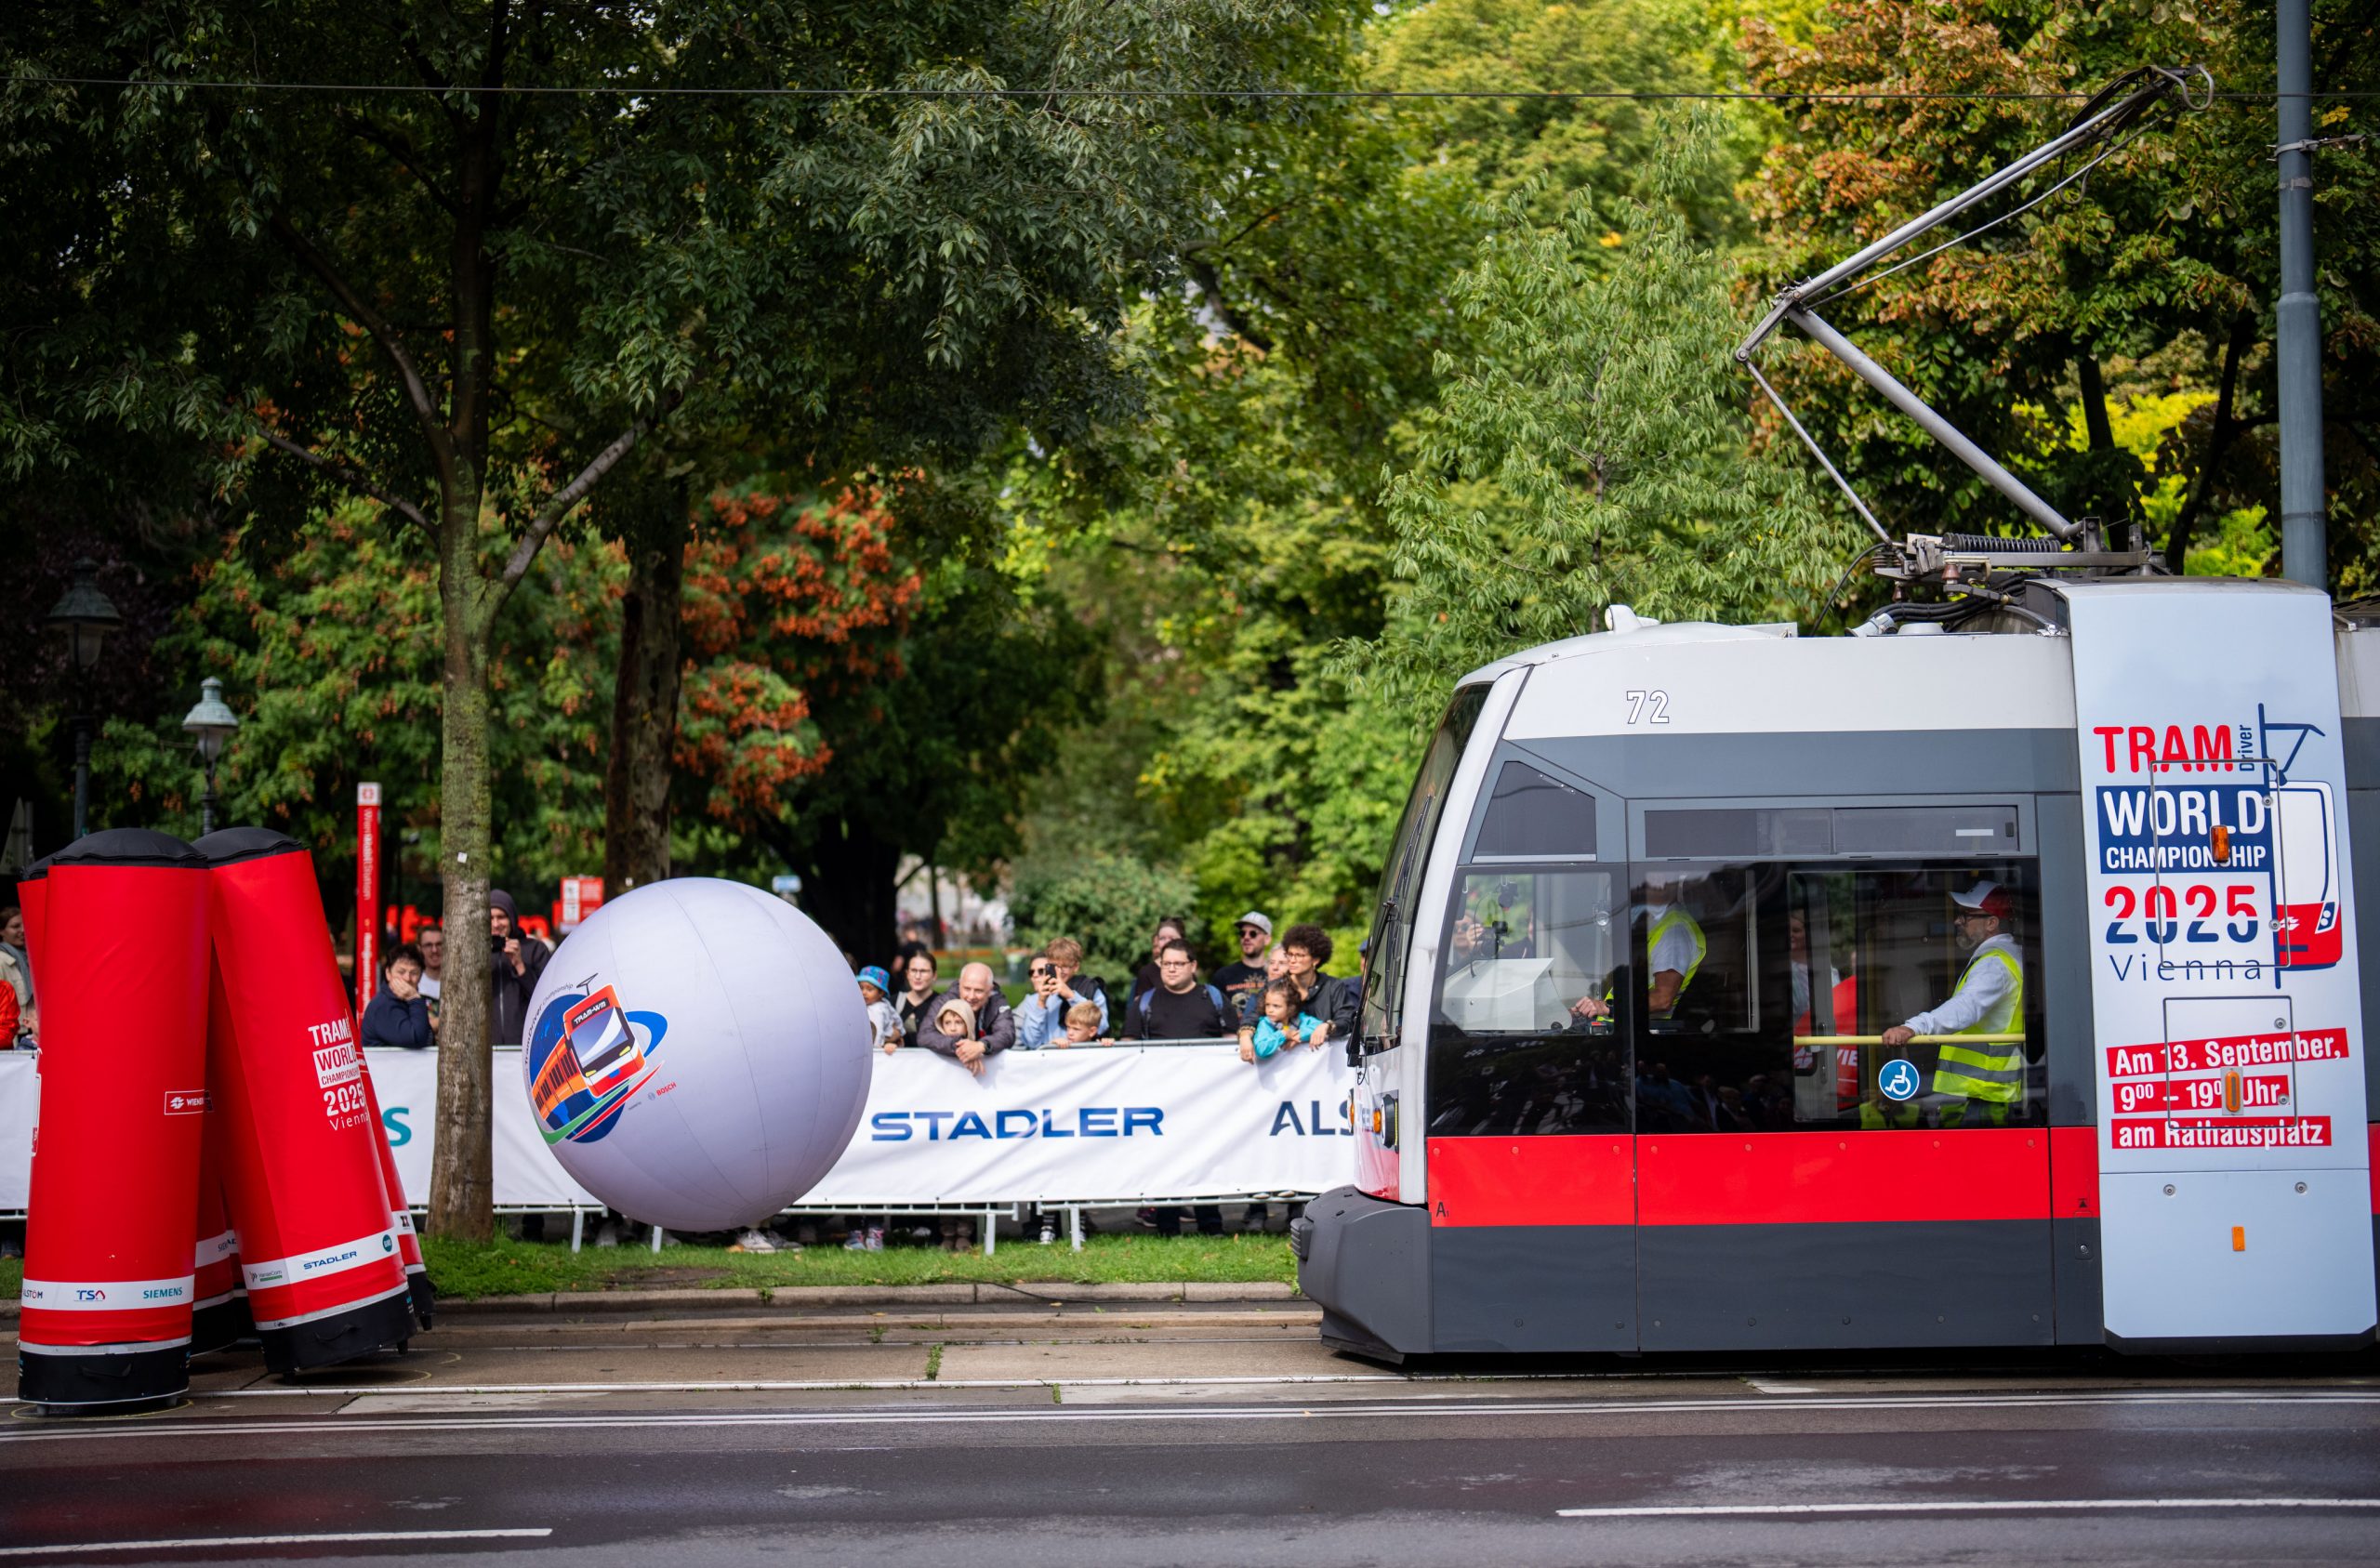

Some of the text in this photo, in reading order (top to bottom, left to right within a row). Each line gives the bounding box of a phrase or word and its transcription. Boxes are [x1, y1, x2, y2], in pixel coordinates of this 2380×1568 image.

[1626, 691, 1670, 724] 72
[2093, 724, 2234, 773] TRAM
[2238, 724, 2254, 771] Driver
[2103, 790, 2266, 836] WORLD
[2106, 846, 2267, 869] CHAMPIONHIP
[2104, 884, 2259, 944] 2025
[2109, 953, 2262, 982] Vienna
[308, 1018, 350, 1047] TRAM
[2115, 1034, 2341, 1075] Am 13. September,
[323, 1082, 366, 1116] 2025
[656, 1081, 677, 1096] BOSCH
[871, 1106, 1164, 1141] STADLER
[2119, 1119, 2324, 1151] am Rathausplatz
[303, 1250, 358, 1271] STADLER
[142, 1286, 183, 1299] SIEMENS
